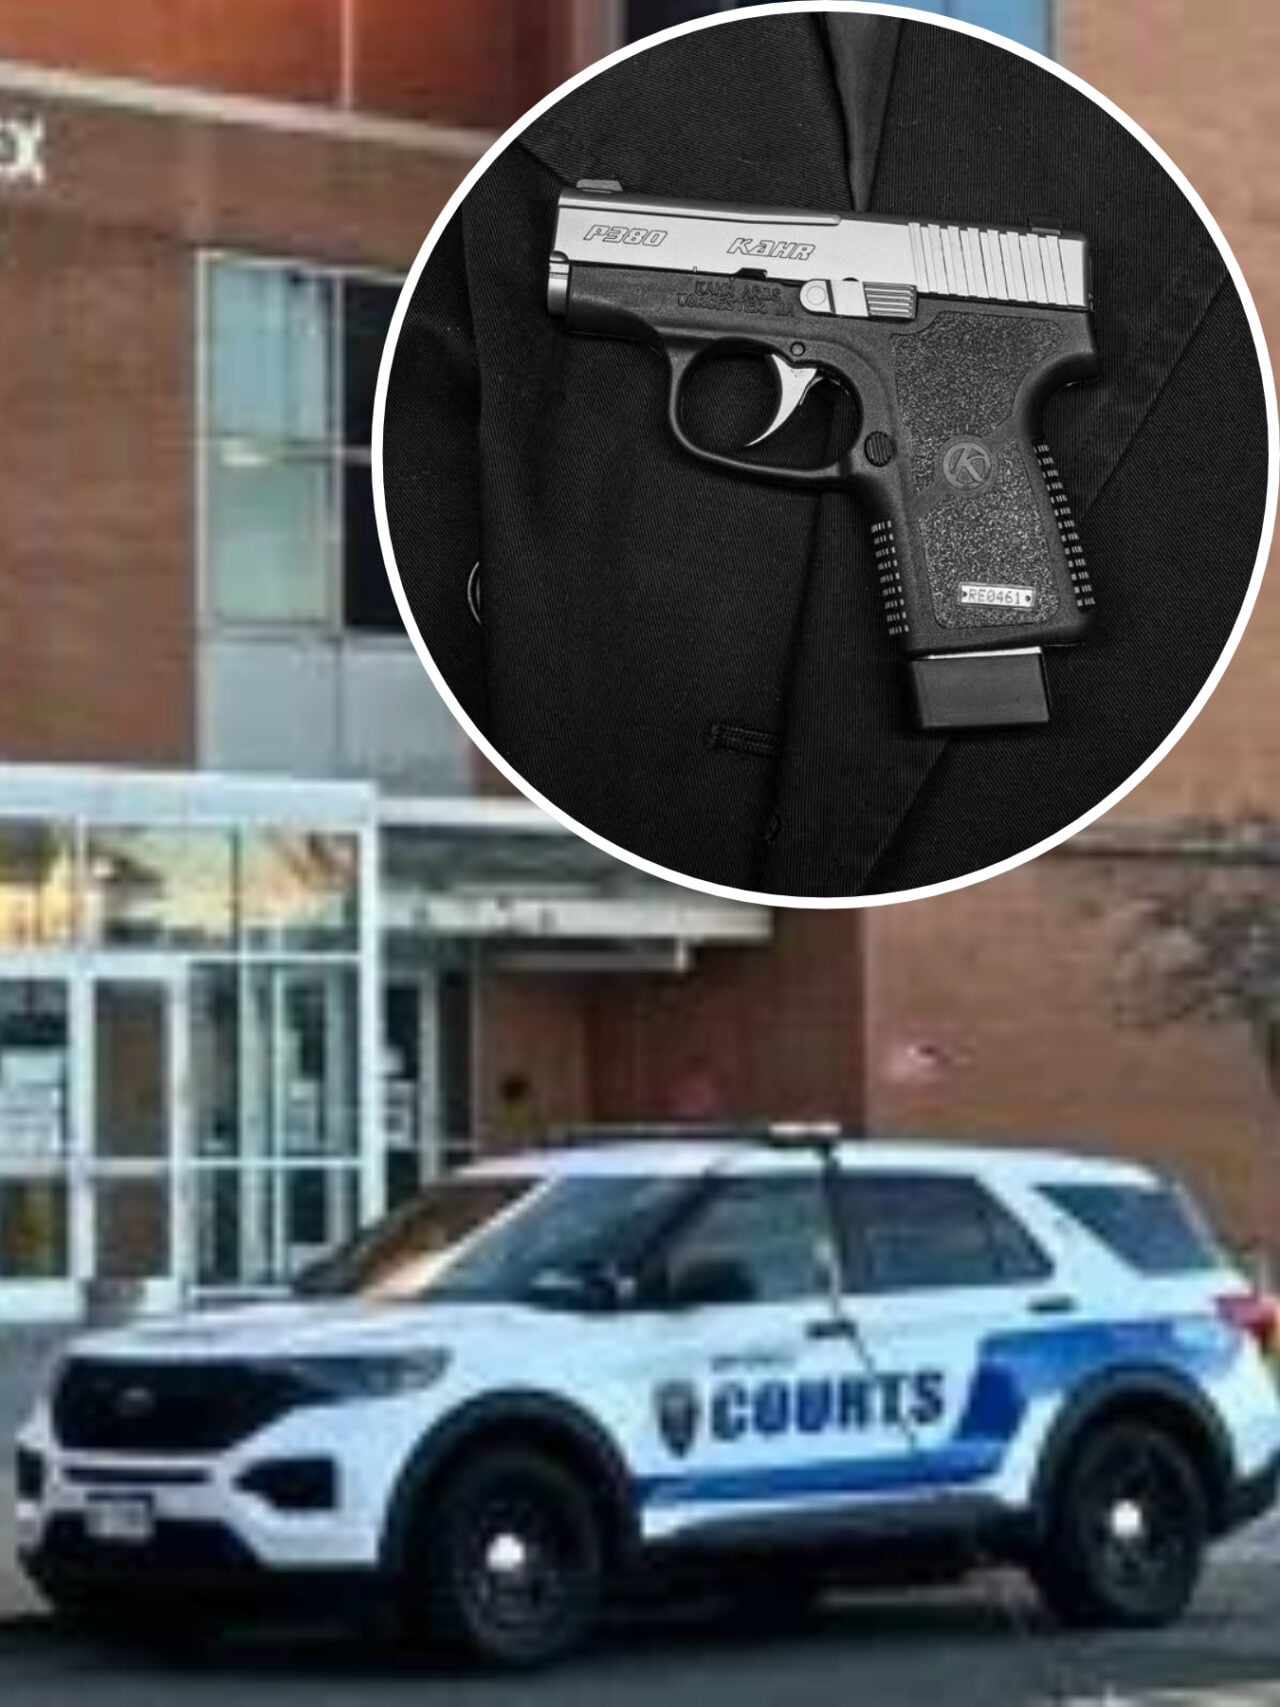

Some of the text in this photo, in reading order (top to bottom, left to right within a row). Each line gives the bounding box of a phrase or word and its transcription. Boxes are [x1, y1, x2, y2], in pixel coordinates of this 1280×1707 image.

[583, 224, 669, 248] P380
[968, 588, 1020, 605] RE0461
[710, 1371, 945, 1443] COURTS
